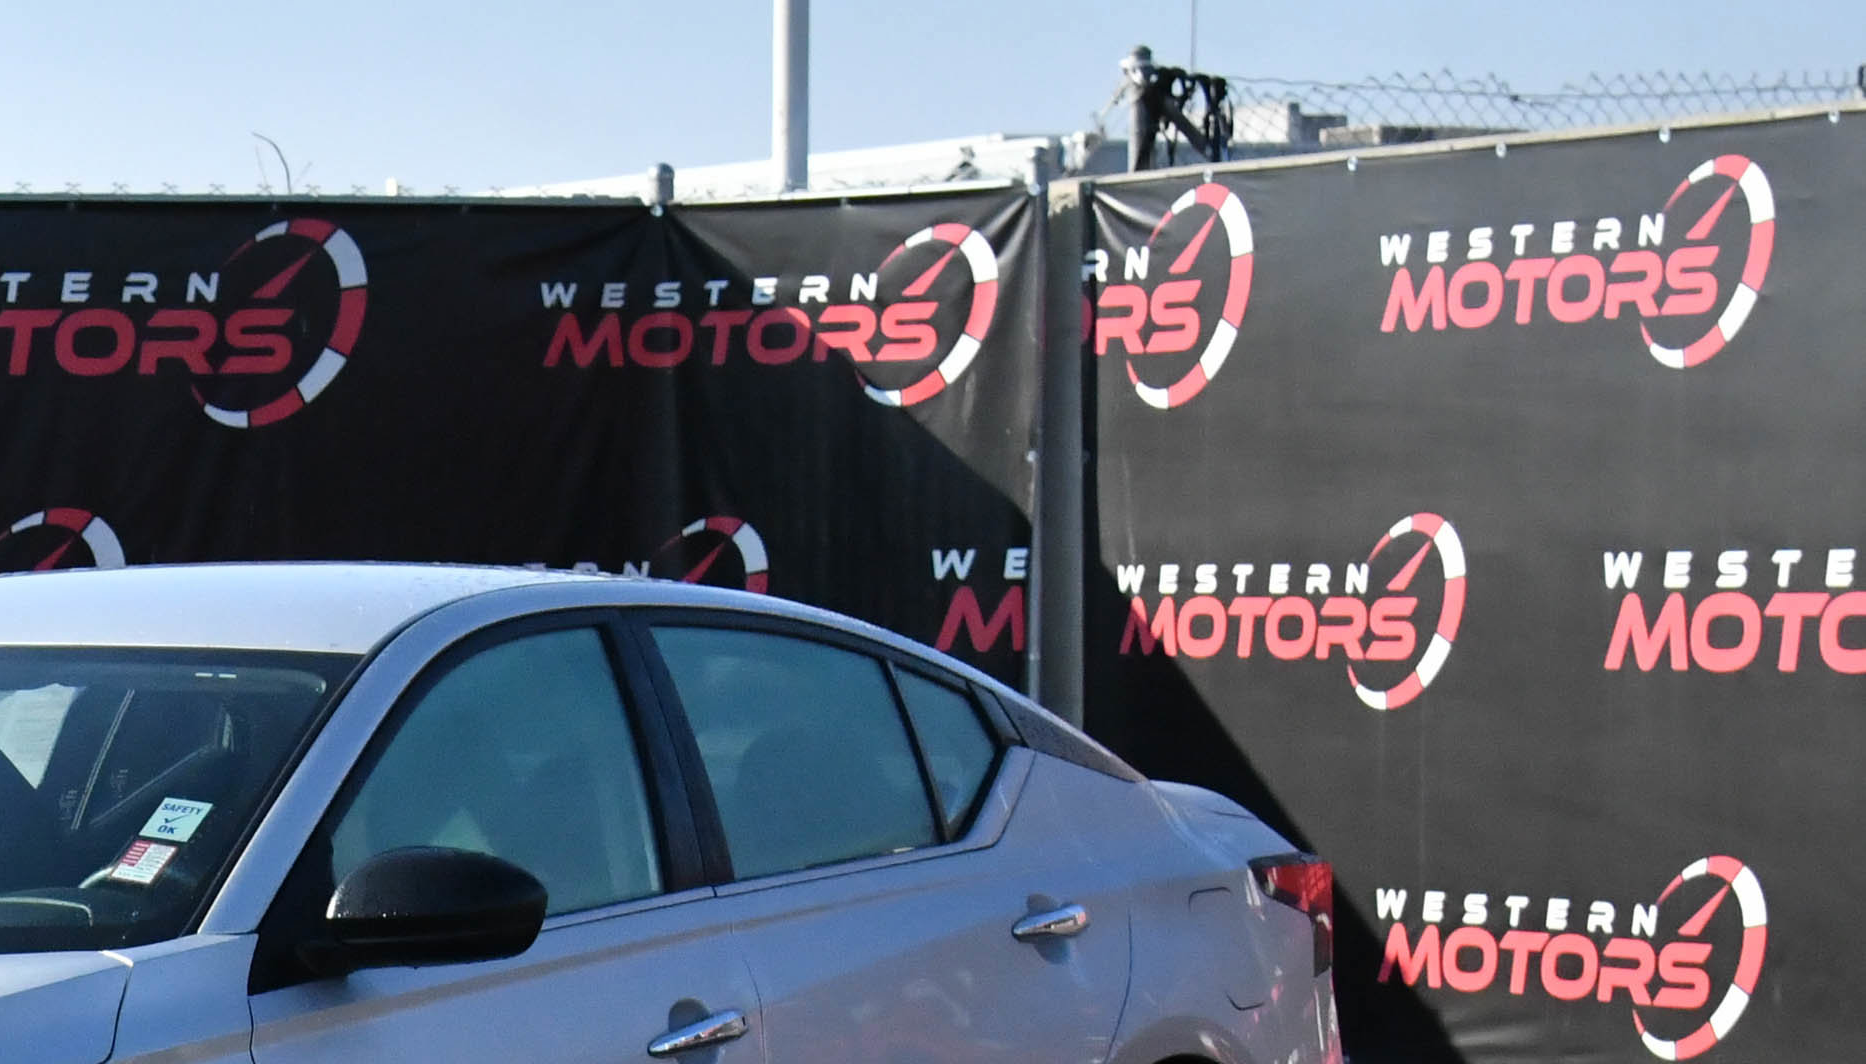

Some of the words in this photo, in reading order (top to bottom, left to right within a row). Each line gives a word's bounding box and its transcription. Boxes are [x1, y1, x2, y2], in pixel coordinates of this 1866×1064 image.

[1380, 213, 1665, 266] WESTERN
[540, 272, 878, 309] WESTERN
[1380, 245, 1720, 333] MOTORS
[543, 301, 939, 367] MOTORS
[1081, 279, 1202, 356] RS
[932, 548, 1029, 580] WE
[1117, 563, 1369, 594] WESTERN
[1603, 548, 1856, 589] WESTE
[1119, 595, 1418, 660] MOTORS
[157, 825, 178, 834] OK
[161, 803, 203, 815] SAFETY
[1376, 888, 1658, 937] WESTERN
[1378, 922, 1713, 1009] MOTORS
